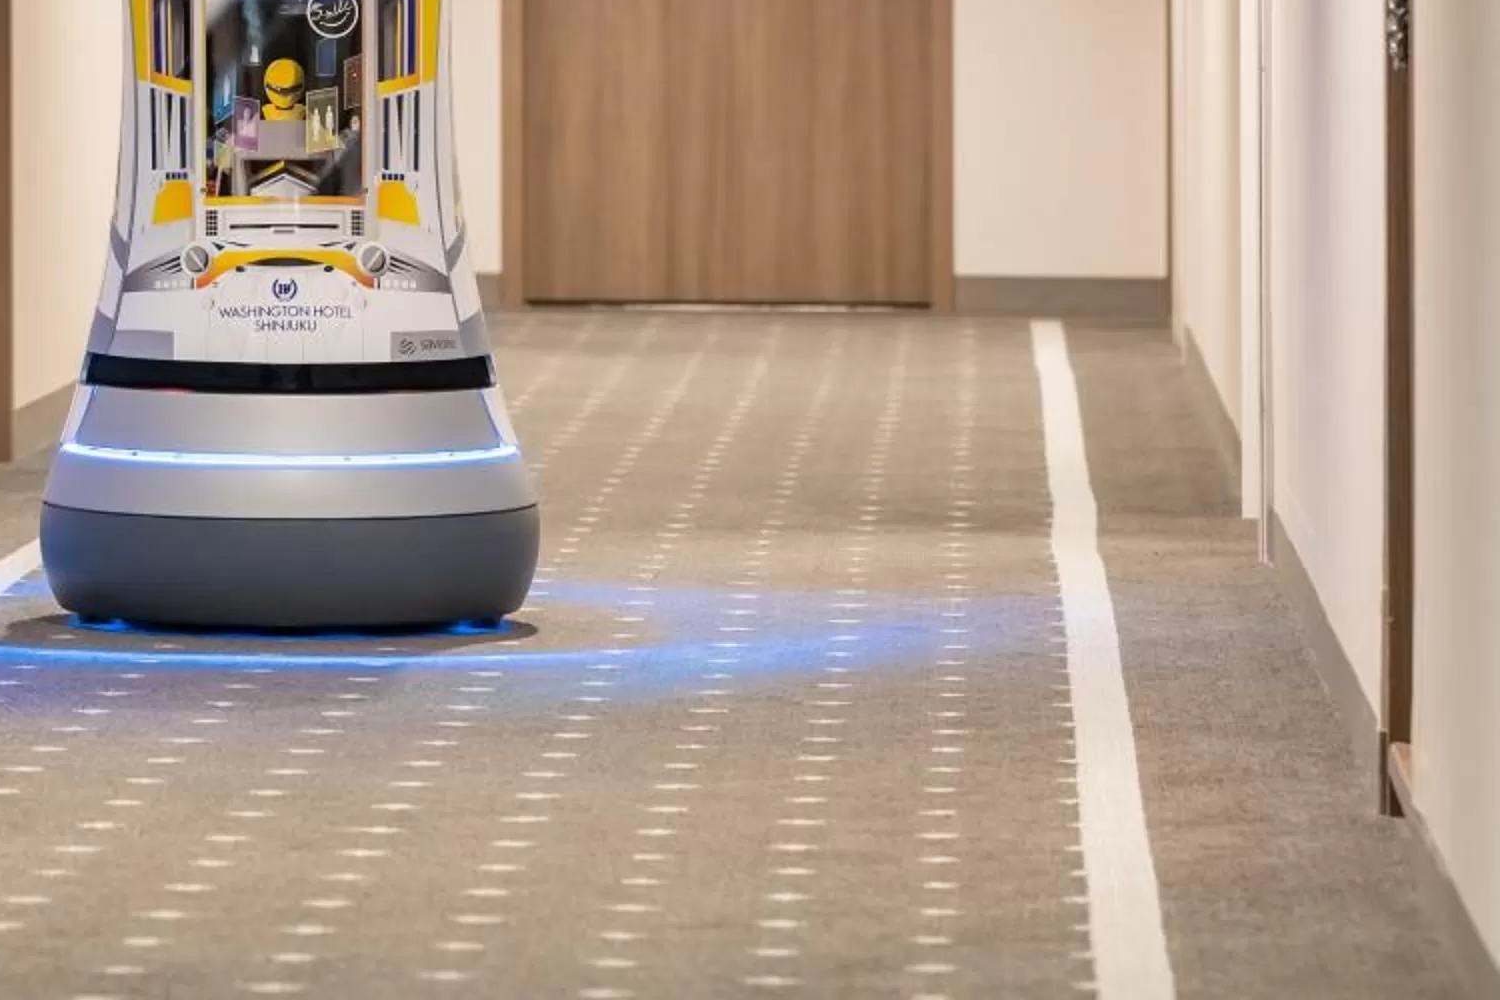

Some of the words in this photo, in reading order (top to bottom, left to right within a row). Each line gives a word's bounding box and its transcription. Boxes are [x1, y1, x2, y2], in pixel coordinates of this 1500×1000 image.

[219, 306, 309, 318] WASHINGTON
[313, 305, 354, 318] HOTEL
[256, 320, 316, 331] SHINJUKU
